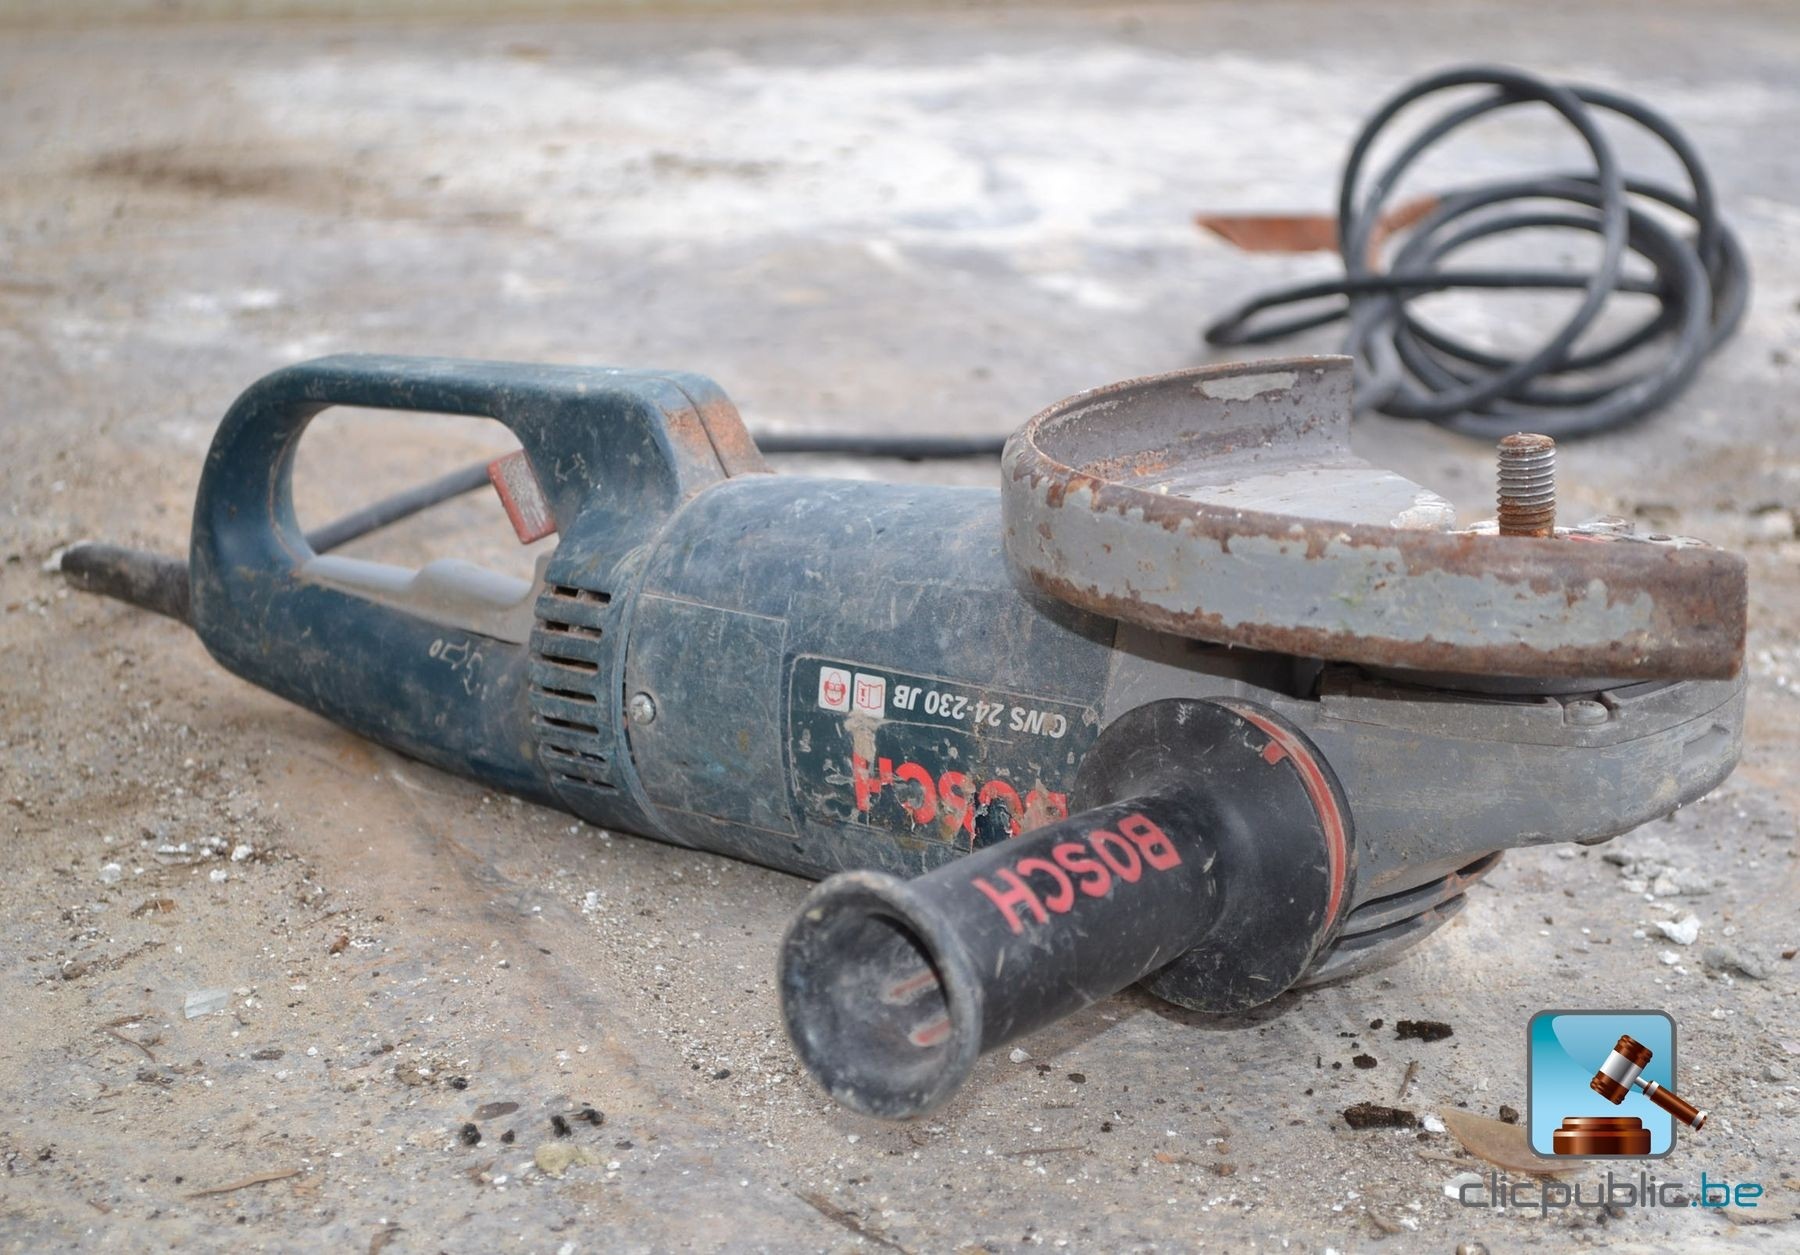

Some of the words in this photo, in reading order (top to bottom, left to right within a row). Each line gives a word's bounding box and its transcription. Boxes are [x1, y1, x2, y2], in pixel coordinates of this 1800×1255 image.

[893, 684, 922, 711] JB
[924, 690, 1004, 727] 24-230
[972, 813, 1182, 936] BOSCH
